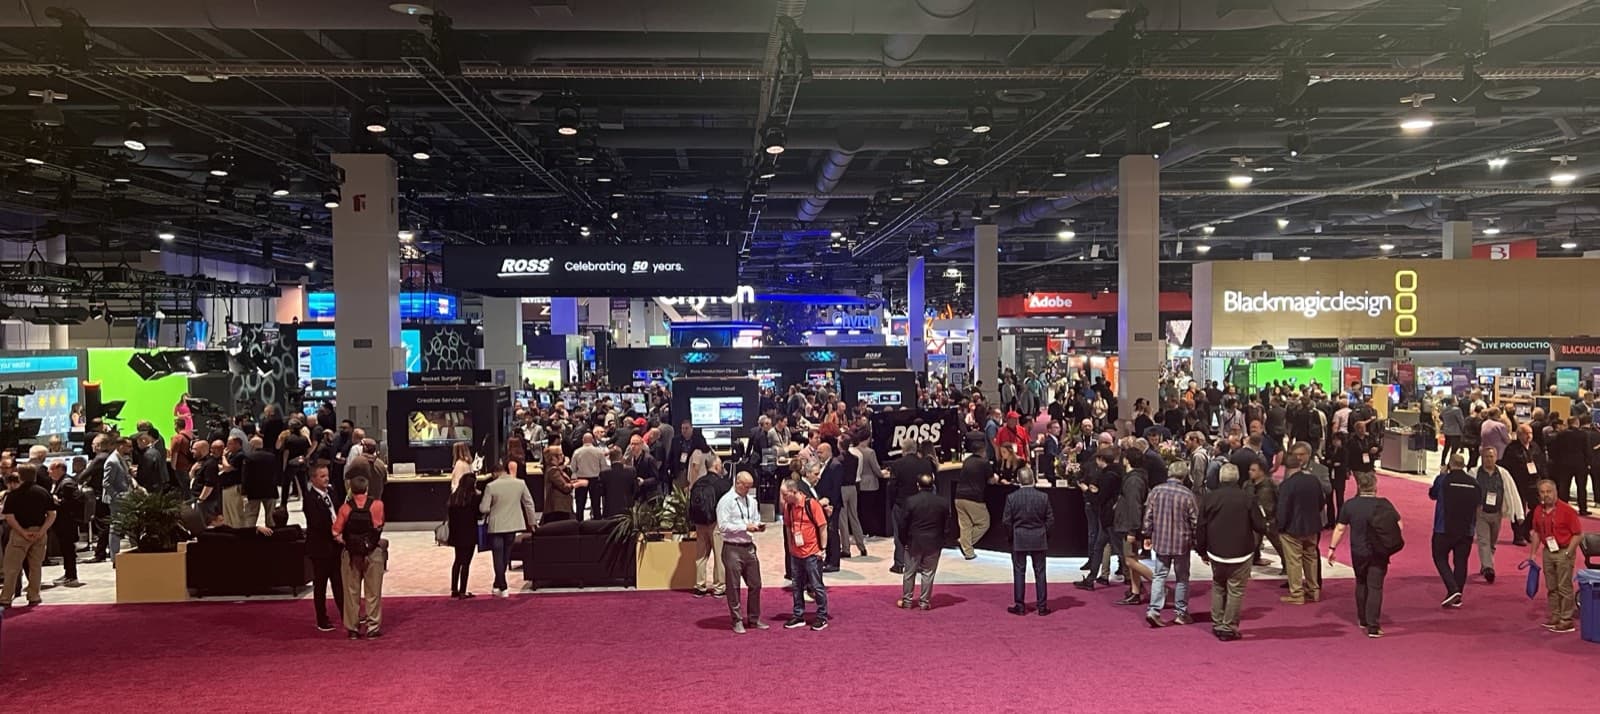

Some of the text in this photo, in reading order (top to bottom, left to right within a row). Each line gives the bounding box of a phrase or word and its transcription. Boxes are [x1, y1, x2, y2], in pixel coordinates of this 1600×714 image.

[501, 259, 684, 274] ROSS Celebrating 50 years.
[1029, 296, 1073, 308] Adobe
[1223, 291, 1392, 317] Blackmagicdesign
[1481, 342, 1499, 350] LIVE
[891, 422, 942, 448] ROSS
